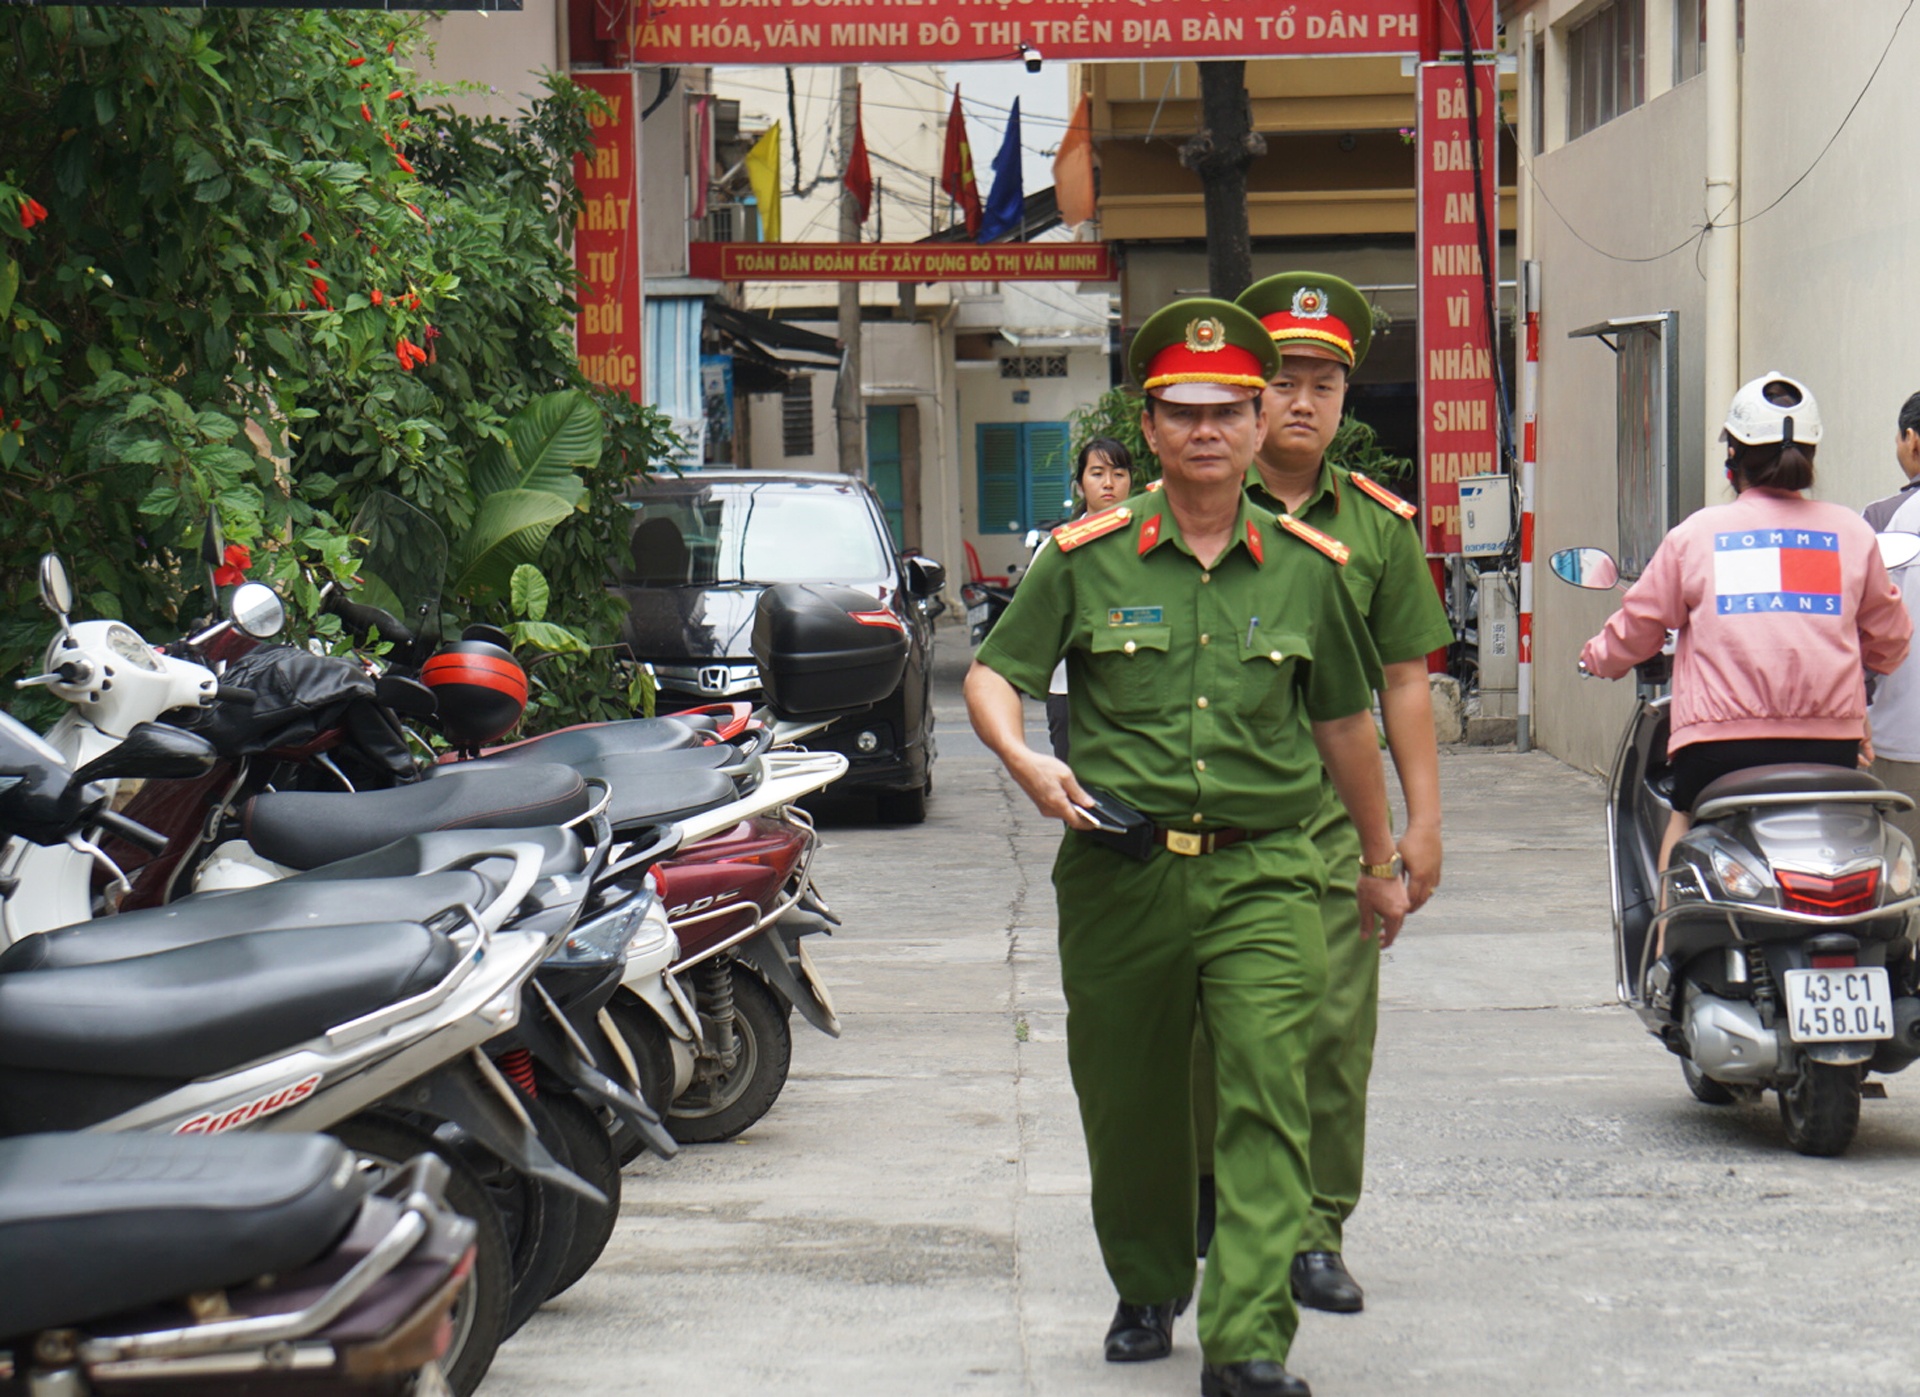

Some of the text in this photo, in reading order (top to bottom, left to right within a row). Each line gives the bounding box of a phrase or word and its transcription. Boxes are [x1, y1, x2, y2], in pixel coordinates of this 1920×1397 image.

[626, 19, 681, 47] VĂN
[831, 22, 908, 46] MINH
[918, 16, 961, 46] ĐÔ
[970, 21, 1021, 50] THỊ
[1031, 14, 1112, 44] TRÊN
[1122, 19, 1172, 48] ĐỊA
[1182, 12, 1243, 42] BÀN
[1255, 5, 1296, 40] TỔ
[1306, 10, 1368, 39] DÂN
[1378, 14, 1418, 37] PH
[1444, 192, 1475, 224] AN
[586, 246, 618, 289] TỰ
[1058, 254, 1097, 271] MINH
[1432, 244, 1483, 276] NINH
[1446, 289, 1470, 327] VÌ
[1430, 342, 1491, 380] NHÂN
[1433, 400, 1487, 432] SINH
[1431, 504, 1461, 535] PH
[1719, 532, 1833, 548] TOMMY
[1724, 595, 1834, 611] JEANS
[1804, 973, 1872, 1003] 43-C1
[1798, 1006, 1886, 1036] 458.04
